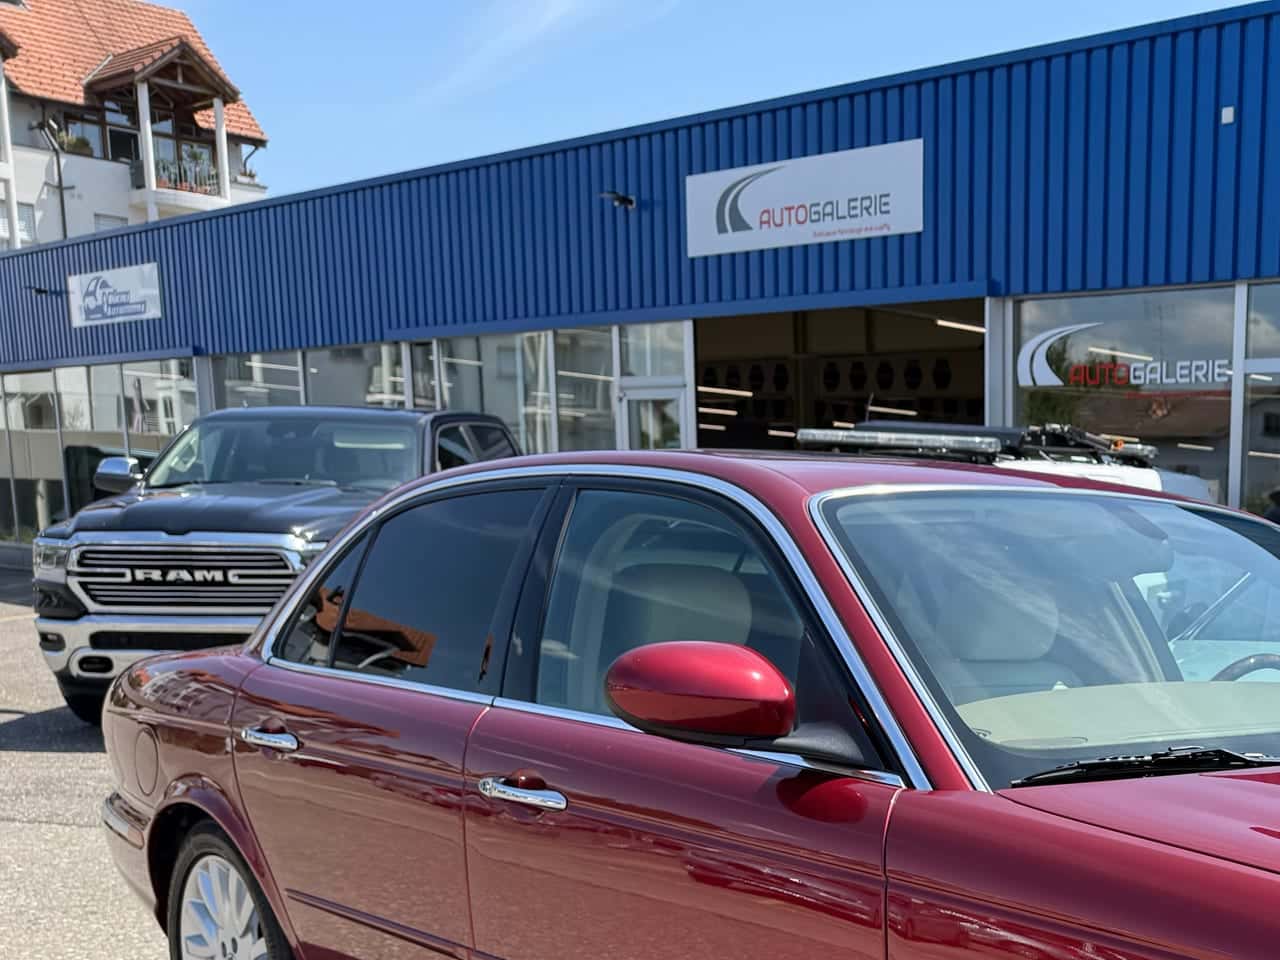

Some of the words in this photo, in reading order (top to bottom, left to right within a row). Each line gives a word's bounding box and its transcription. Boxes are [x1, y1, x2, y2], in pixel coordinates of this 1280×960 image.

[759, 193, 891, 230] AUTOGALERIE
[1069, 360, 1229, 385] AUTOGALERIE
[134, 569, 225, 582] RAM
